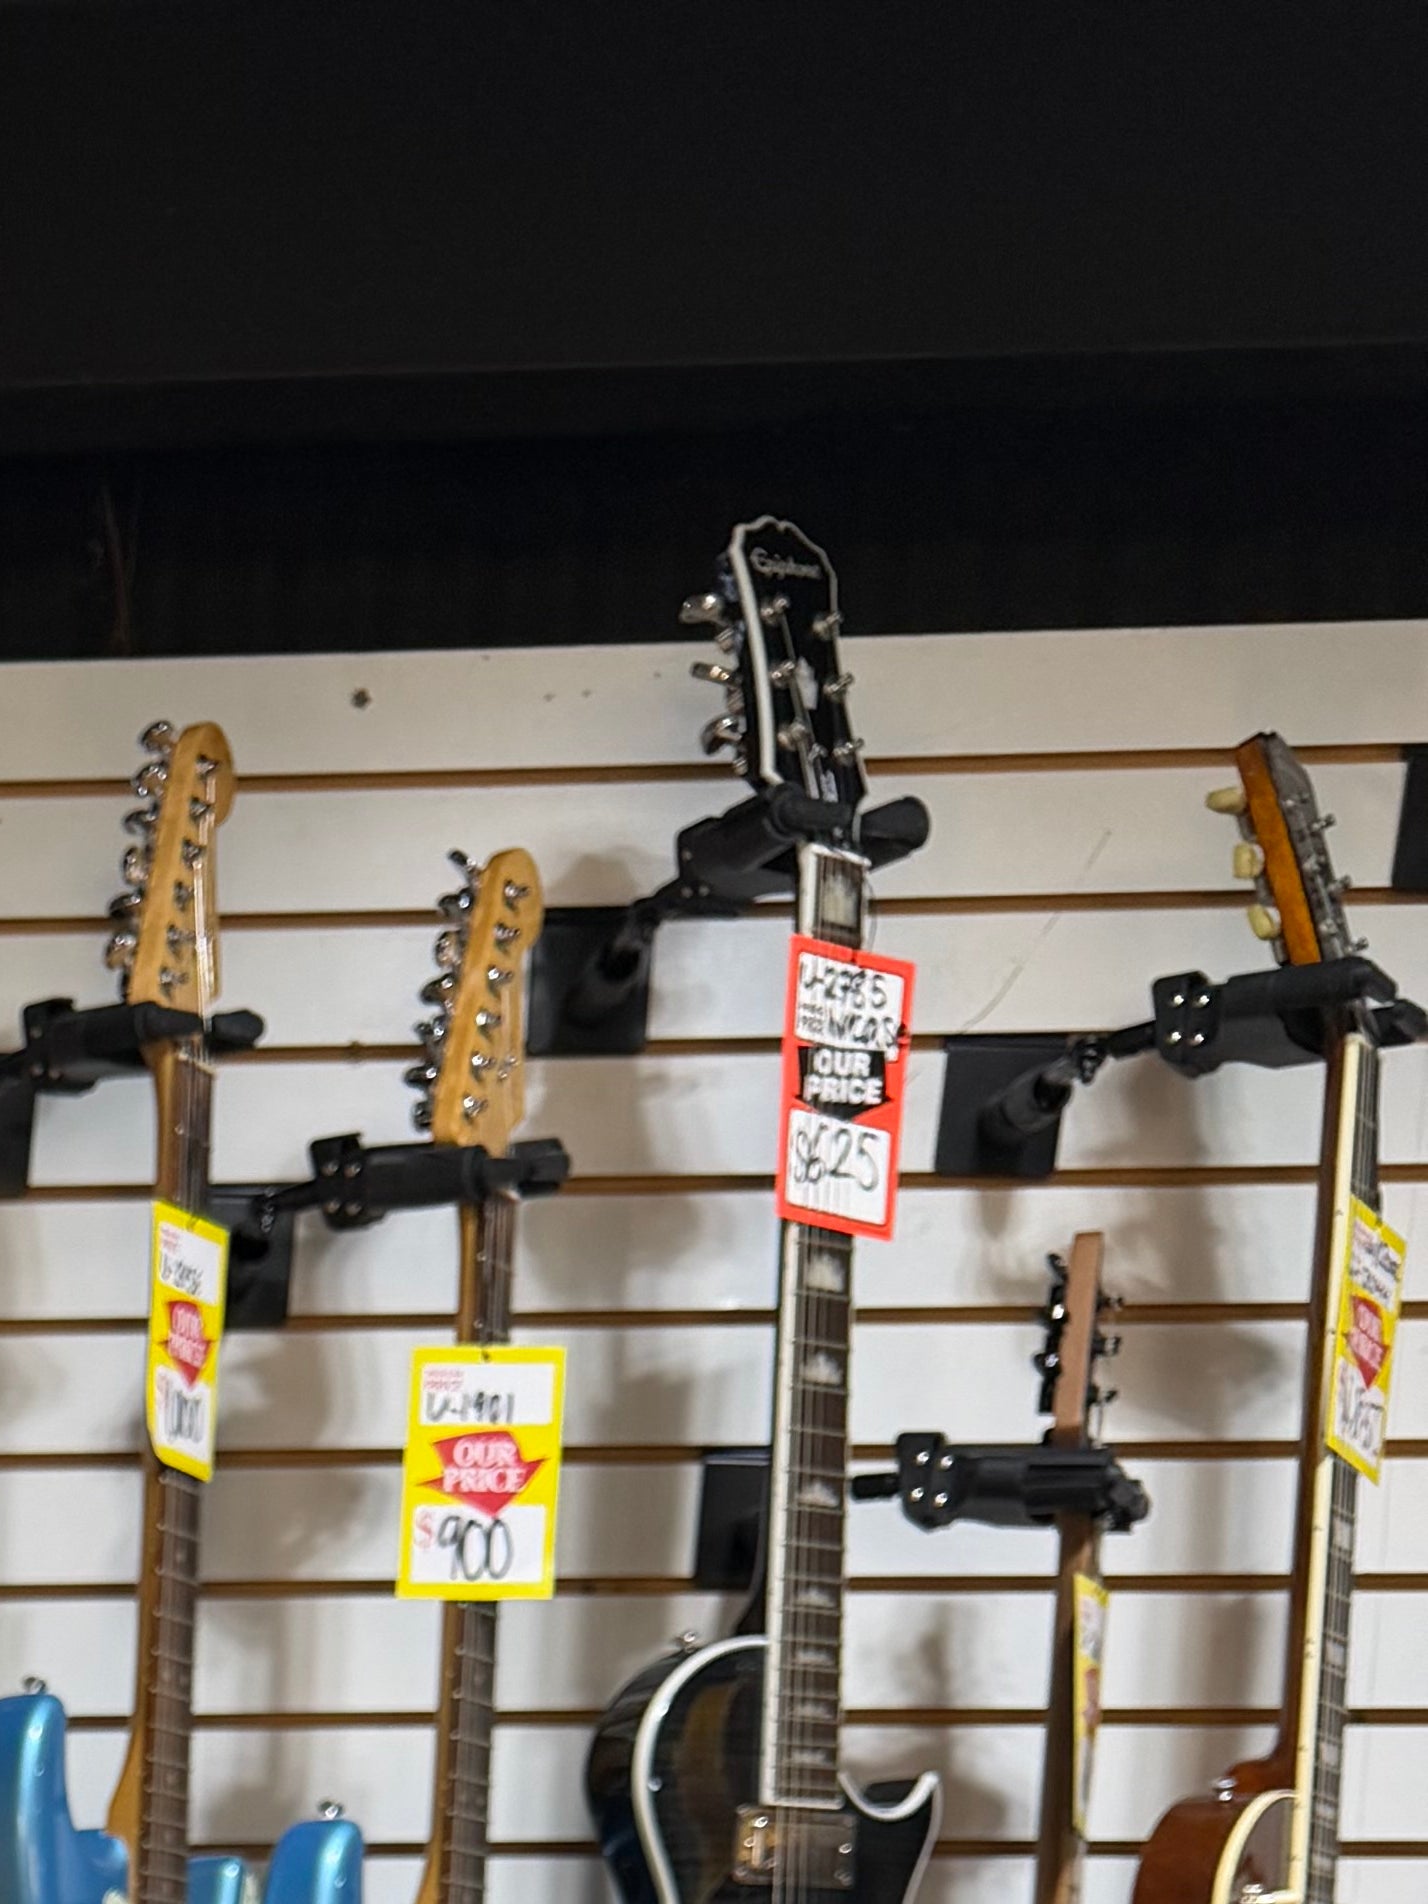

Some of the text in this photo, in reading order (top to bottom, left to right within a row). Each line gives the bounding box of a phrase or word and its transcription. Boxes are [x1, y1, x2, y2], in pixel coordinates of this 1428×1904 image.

[811, 1048, 872, 1078] OUR
[801, 1074, 885, 1106] PRICE
[452, 1436, 521, 1469] OUR
[441, 1466, 528, 1495] PRICE
